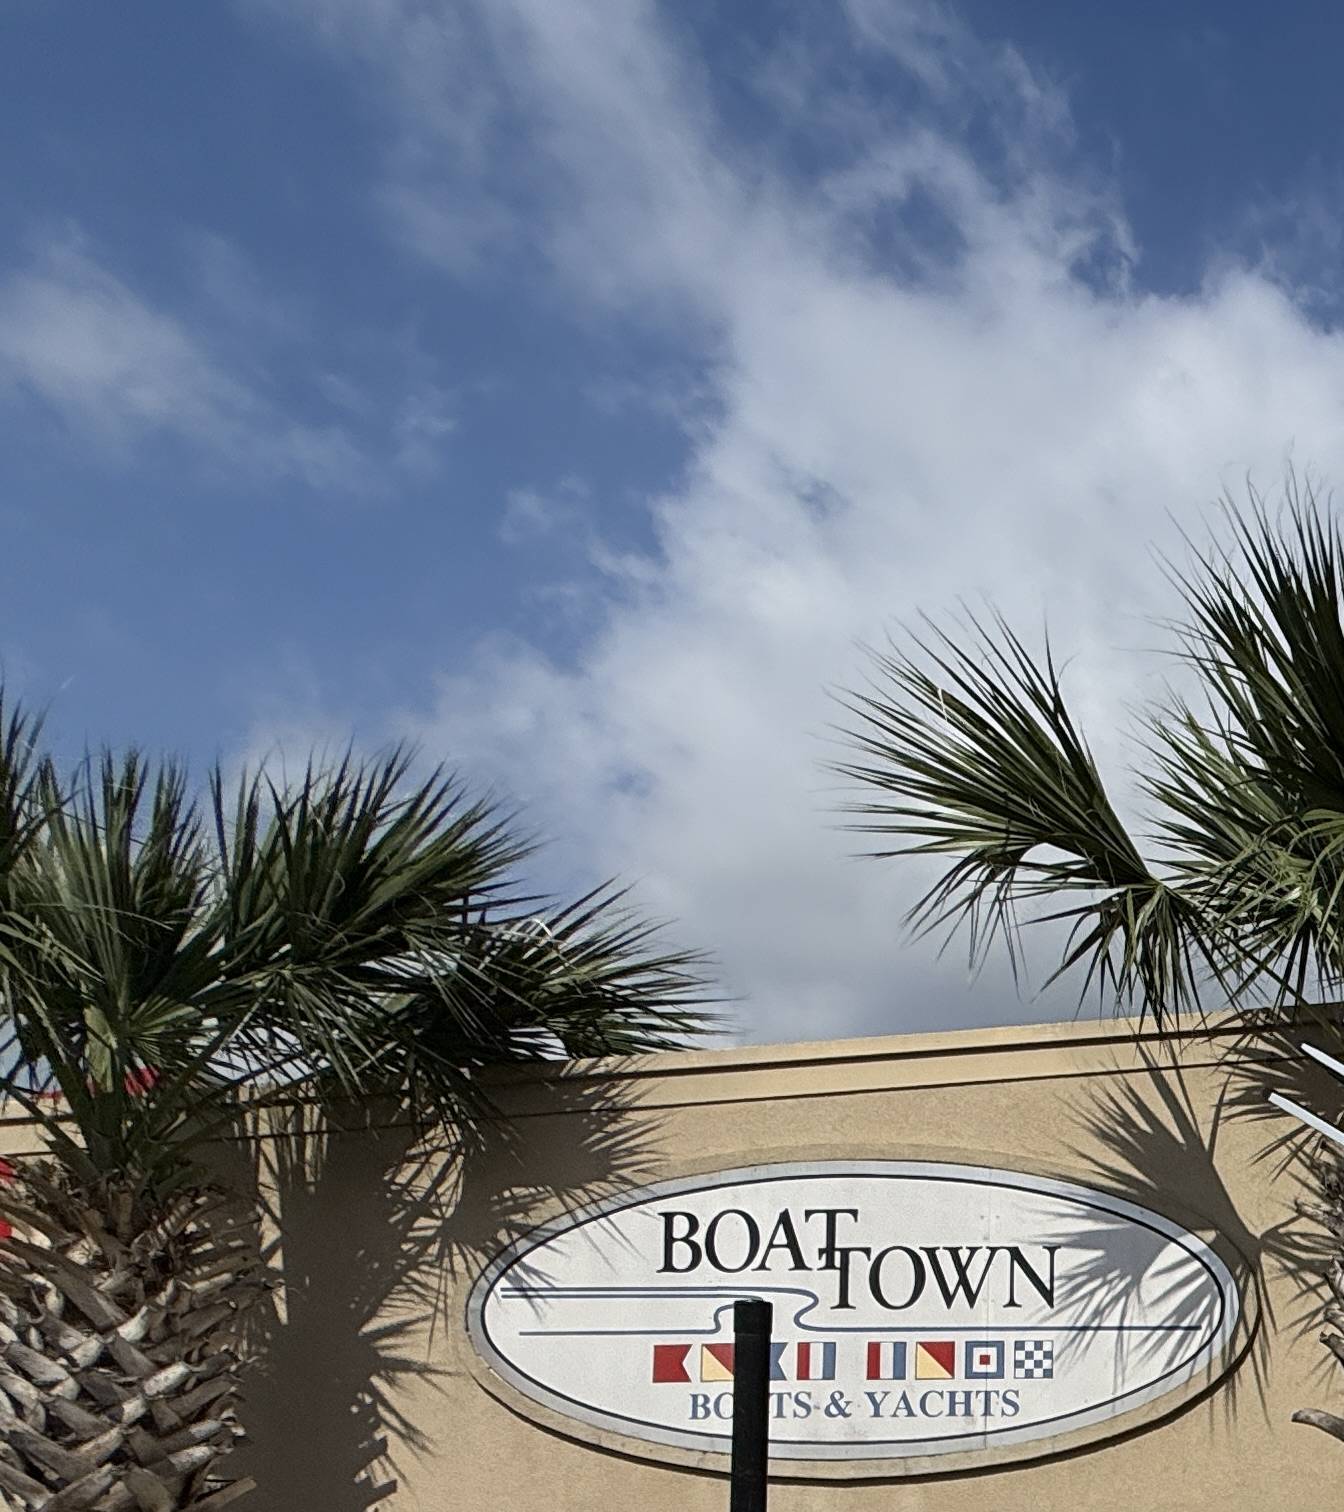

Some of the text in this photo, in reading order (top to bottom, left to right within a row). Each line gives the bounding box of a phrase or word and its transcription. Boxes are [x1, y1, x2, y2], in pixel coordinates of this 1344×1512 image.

[656, 1208, 1062, 1311] BOAT TOWN
[689, 1389, 1021, 1420] BOTS & YACHTS
